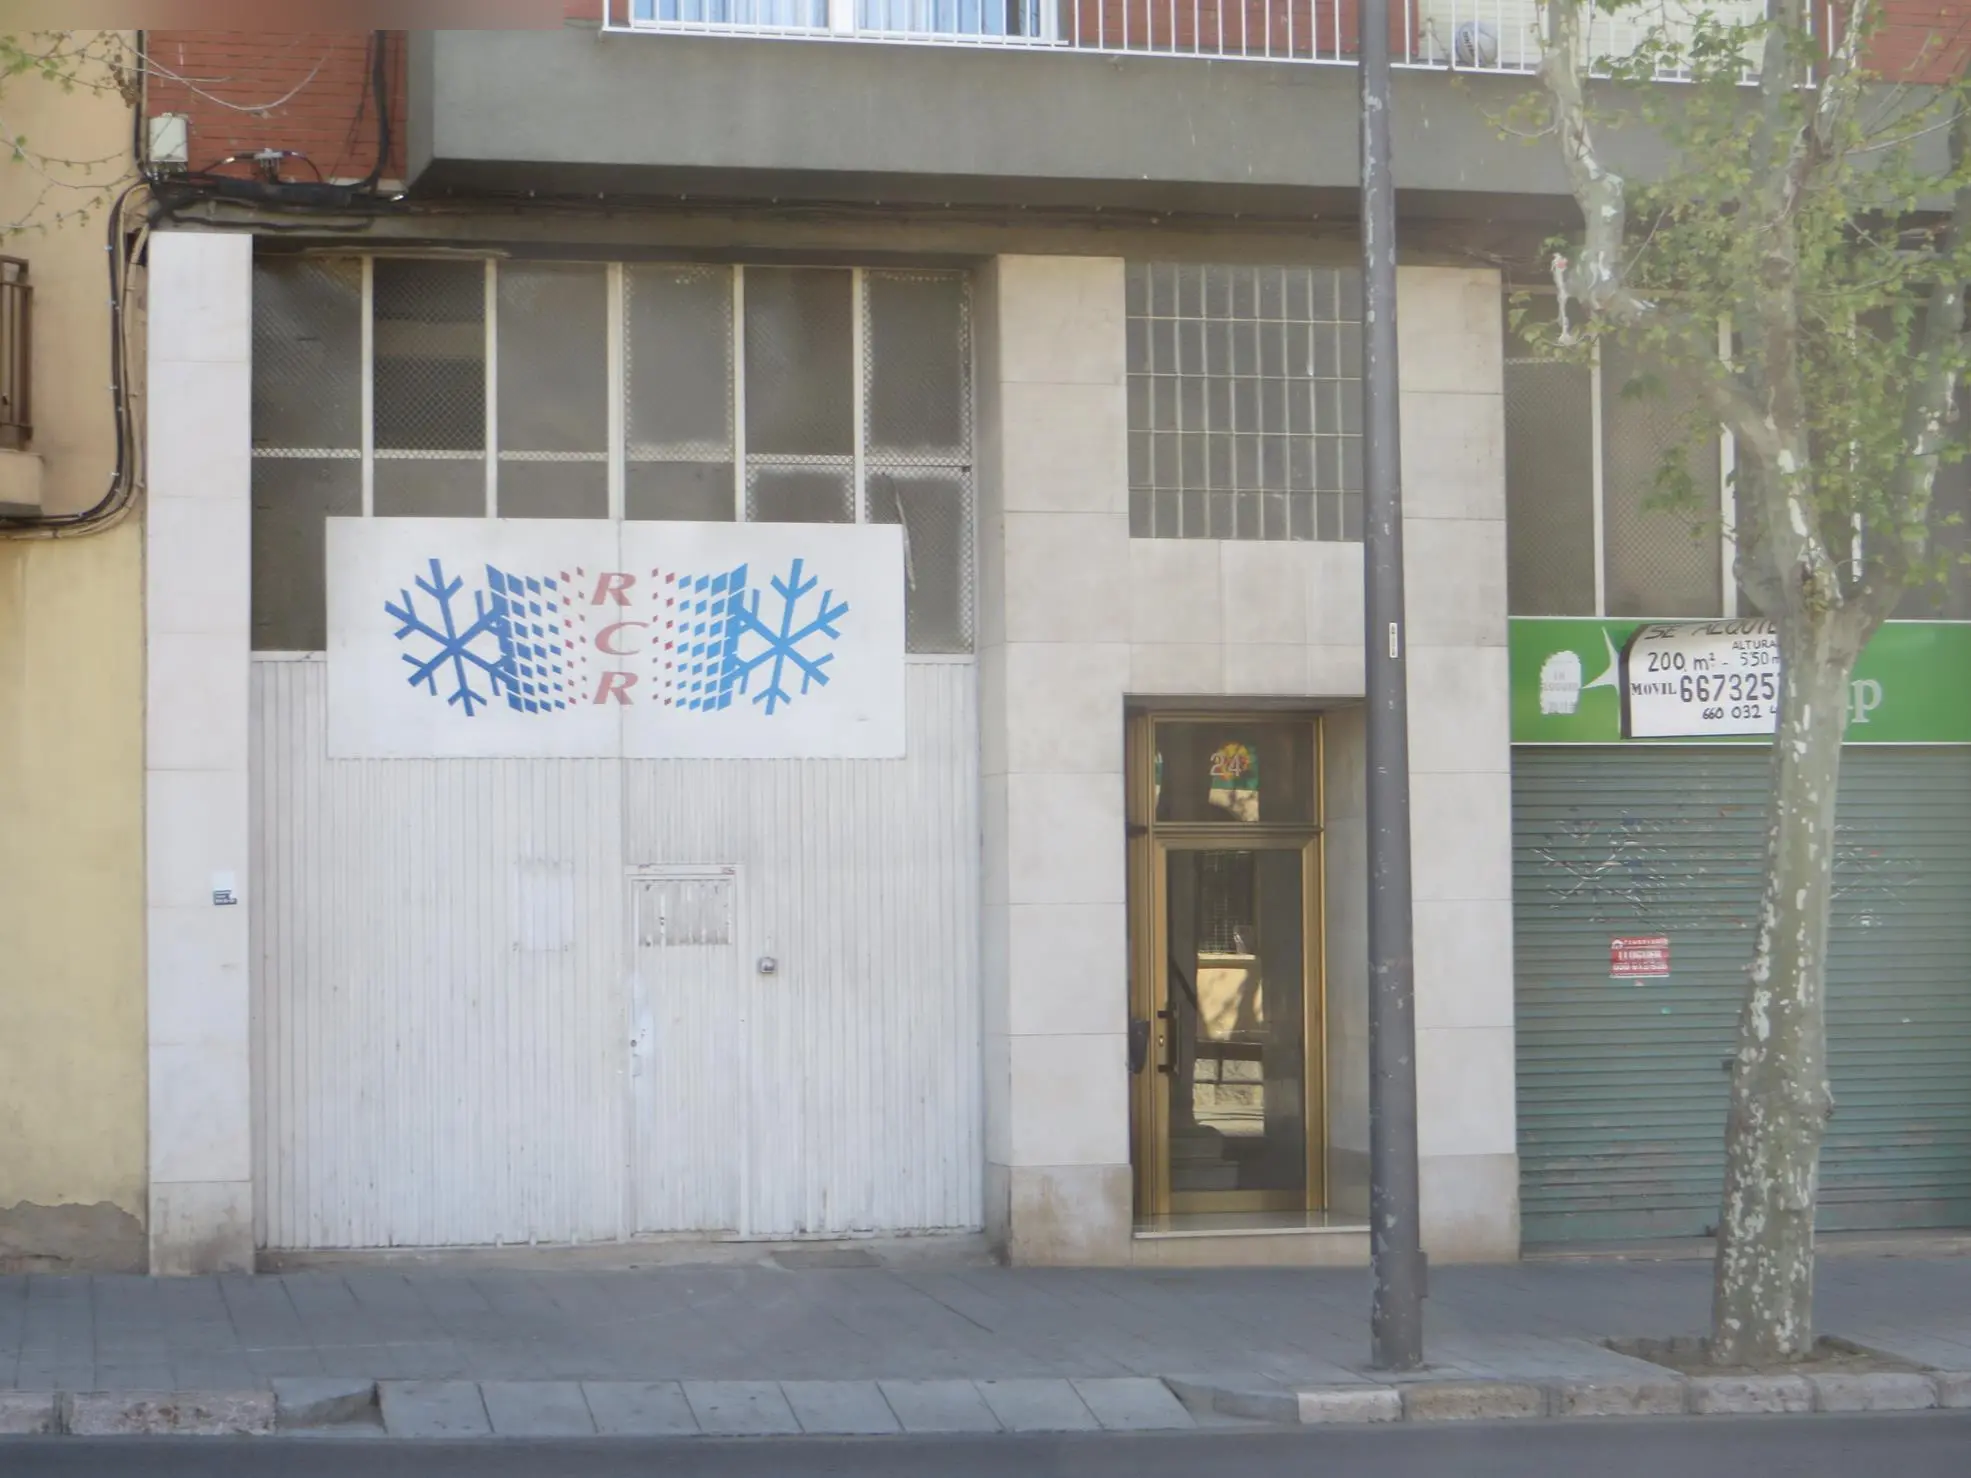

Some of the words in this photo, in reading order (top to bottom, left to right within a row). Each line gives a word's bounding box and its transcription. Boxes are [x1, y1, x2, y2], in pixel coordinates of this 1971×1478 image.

[1645, 624, 1679, 639] SE
[1680, 673, 1780, 703] 667325
[1703, 707, 1724, 720] 660
[1732, 704, 1762, 719] 032
[1210, 753, 1241, 775] 24
